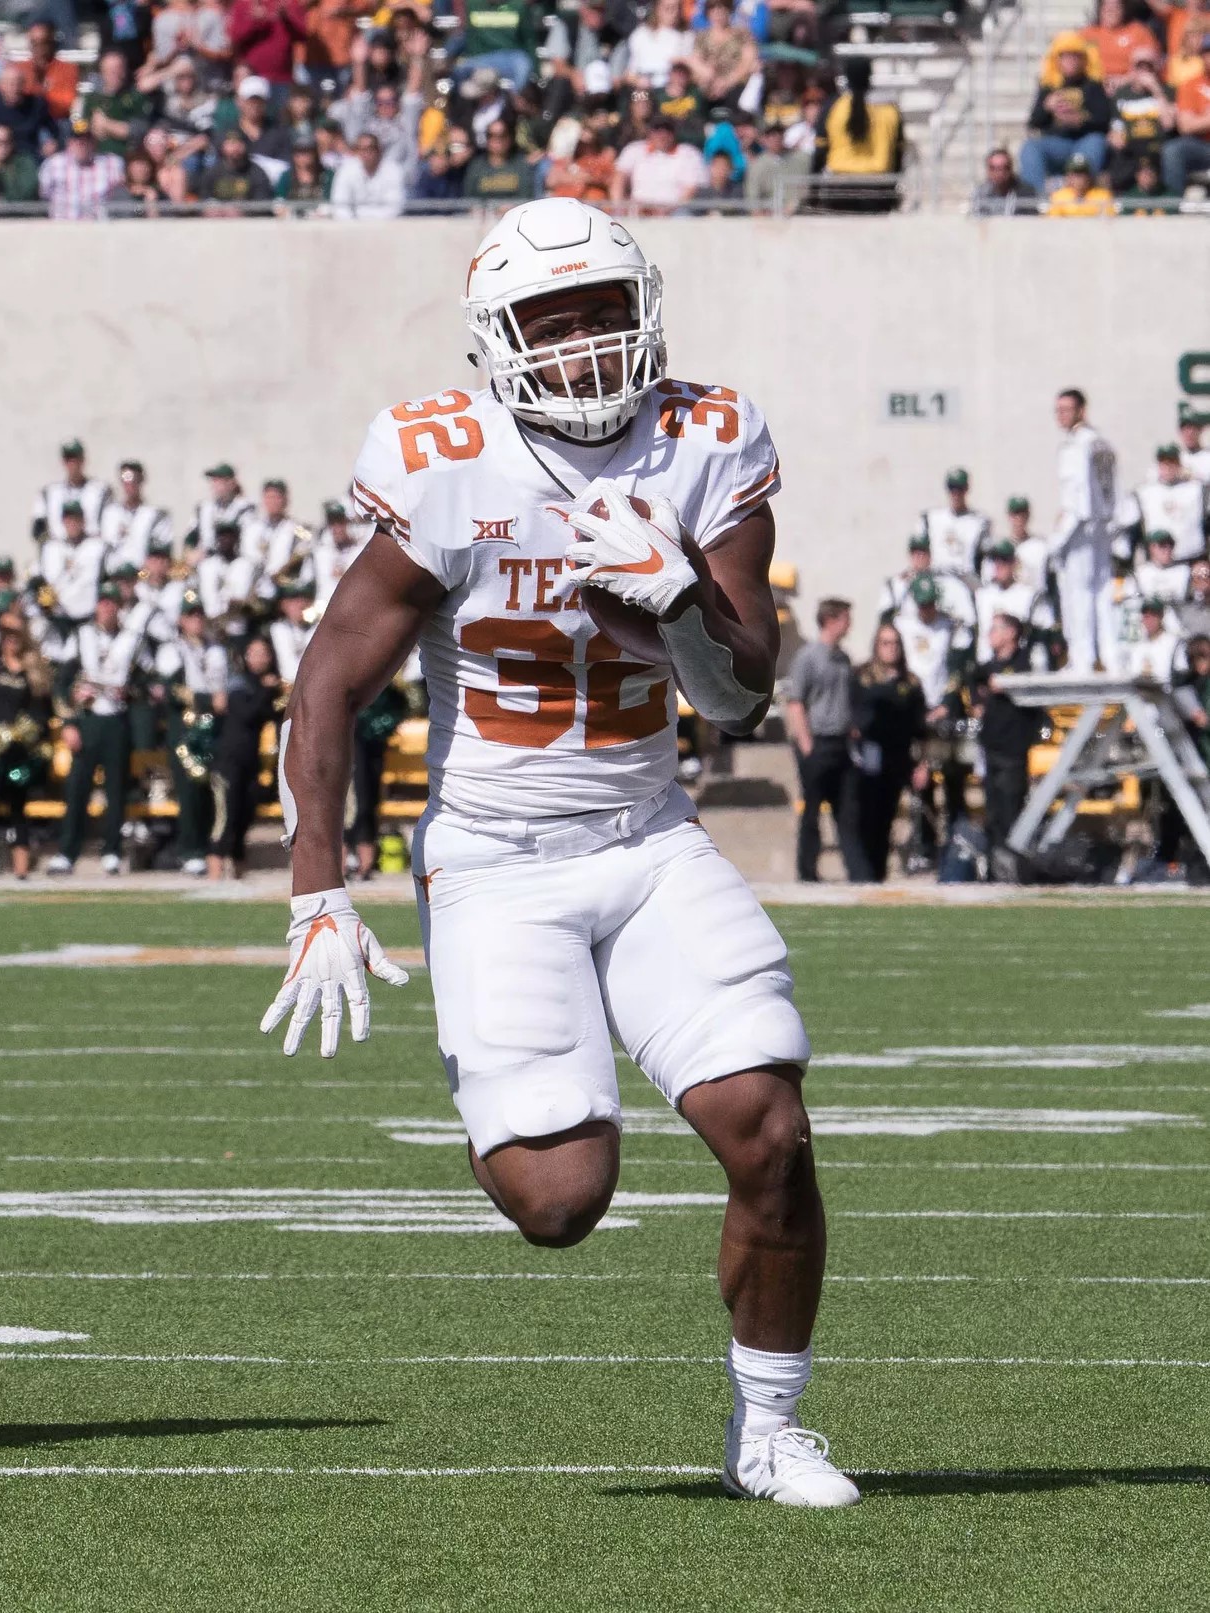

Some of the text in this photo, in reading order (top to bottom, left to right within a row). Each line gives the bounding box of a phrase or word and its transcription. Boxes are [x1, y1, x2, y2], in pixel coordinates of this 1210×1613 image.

[551, 261, 588, 275] HORNS
[390, 389, 486, 475] 32
[472, 518, 516, 541] XII
[459, 616, 671, 749] 32
